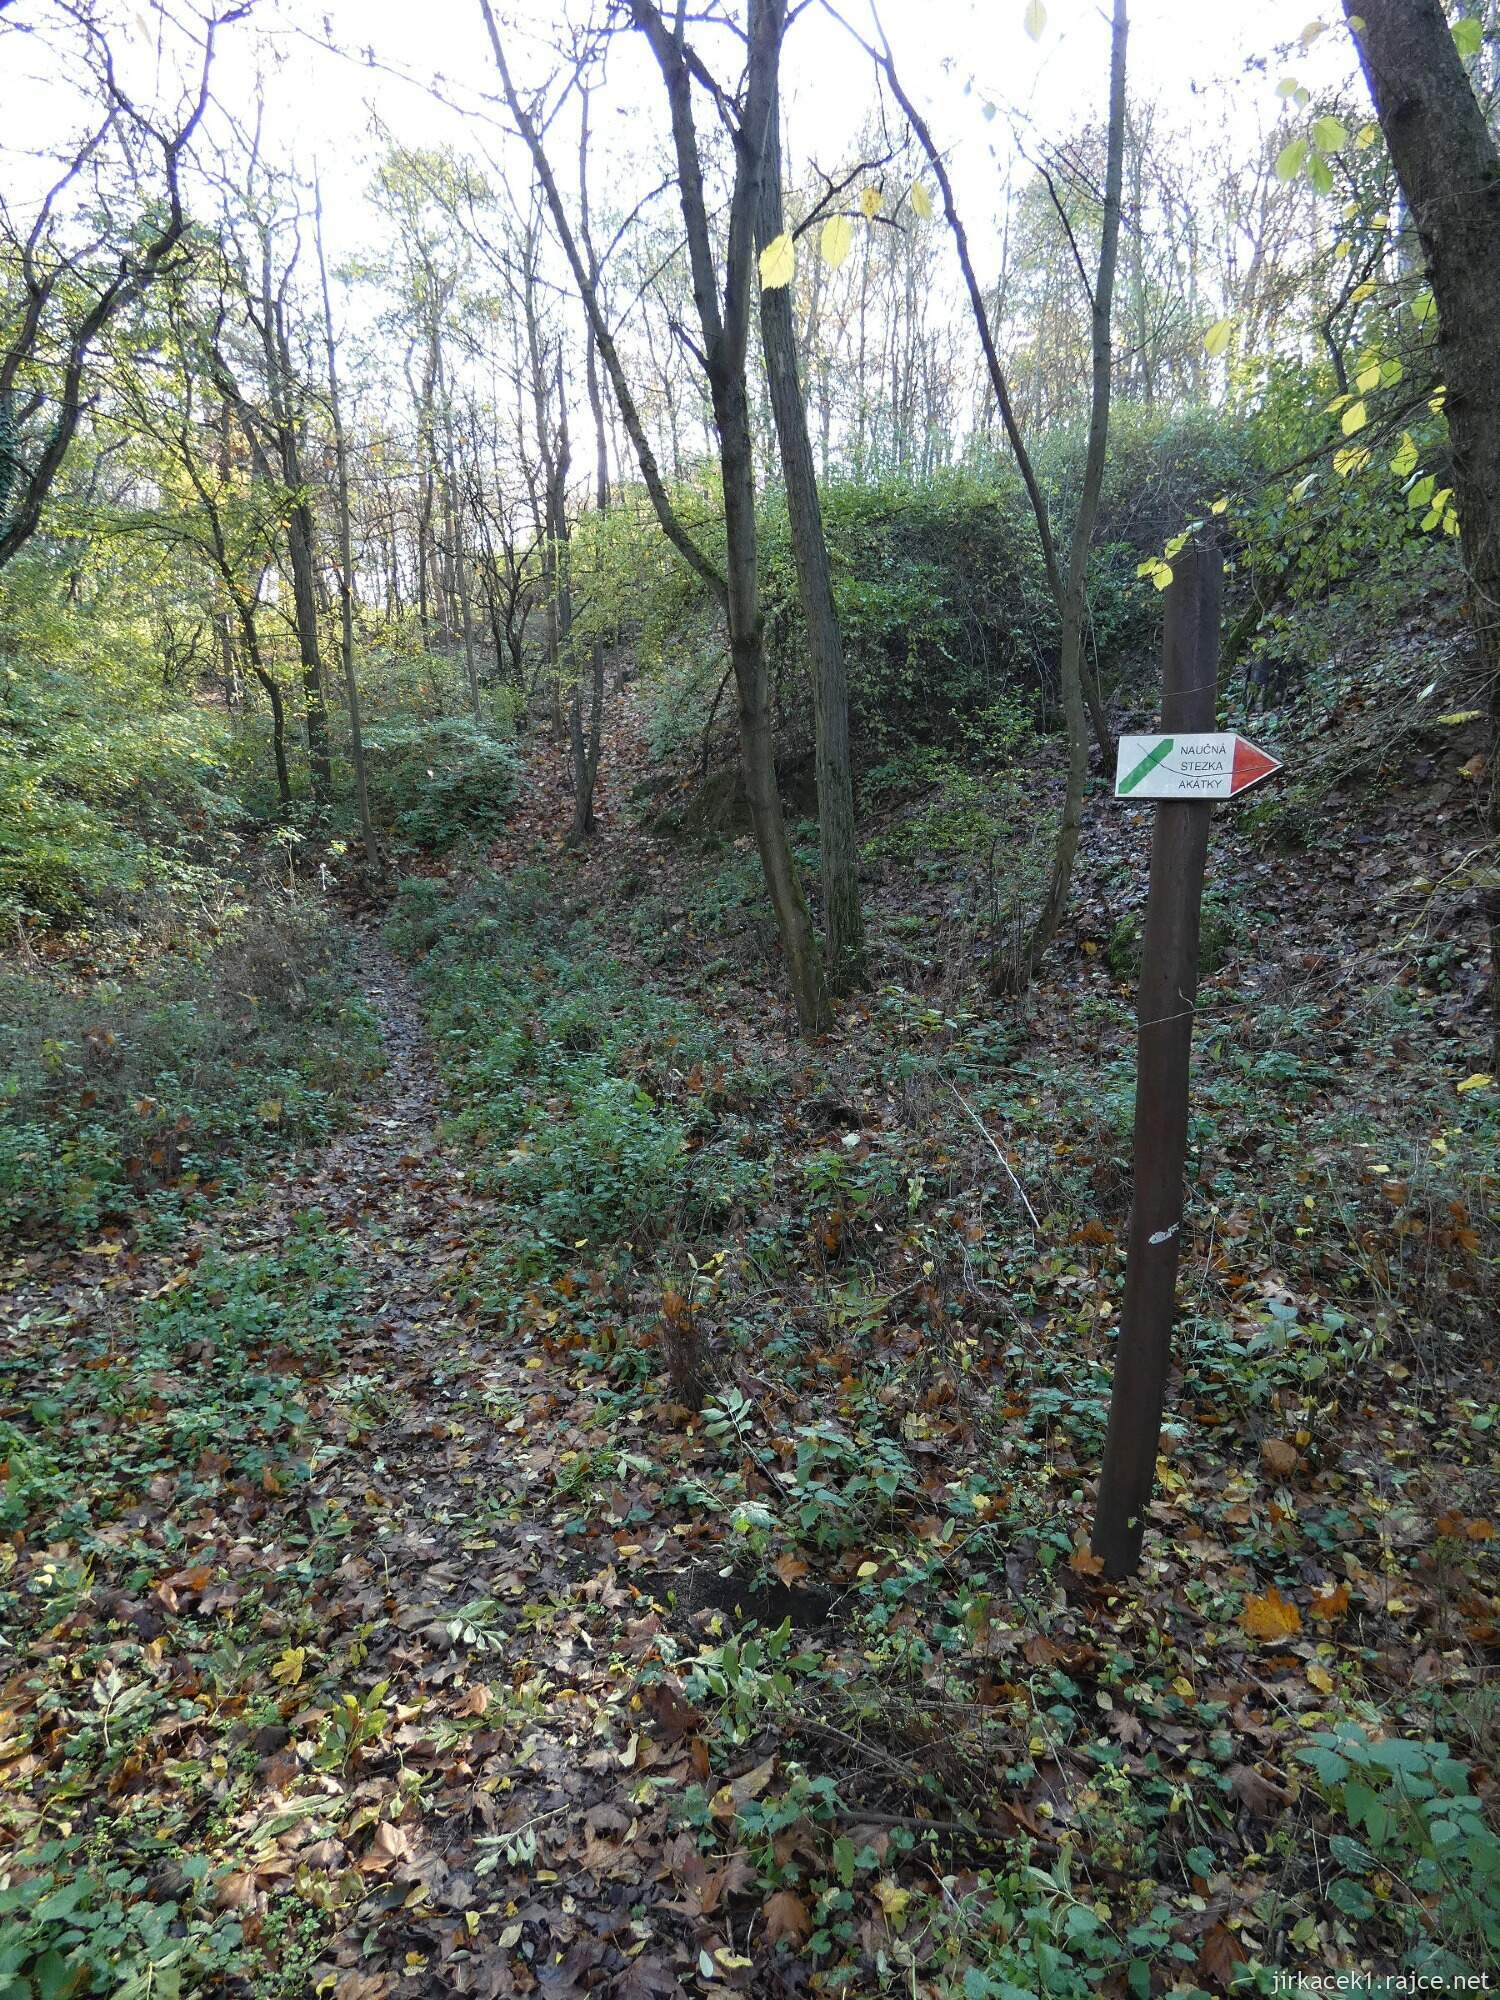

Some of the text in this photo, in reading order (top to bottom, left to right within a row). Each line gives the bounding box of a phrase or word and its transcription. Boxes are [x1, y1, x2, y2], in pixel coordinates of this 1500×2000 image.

[1180, 743, 1226, 755] NAUČNÁ
[1180, 761, 1223, 771] STEZKA
[1178, 777, 1222, 789] AKÁTKY
